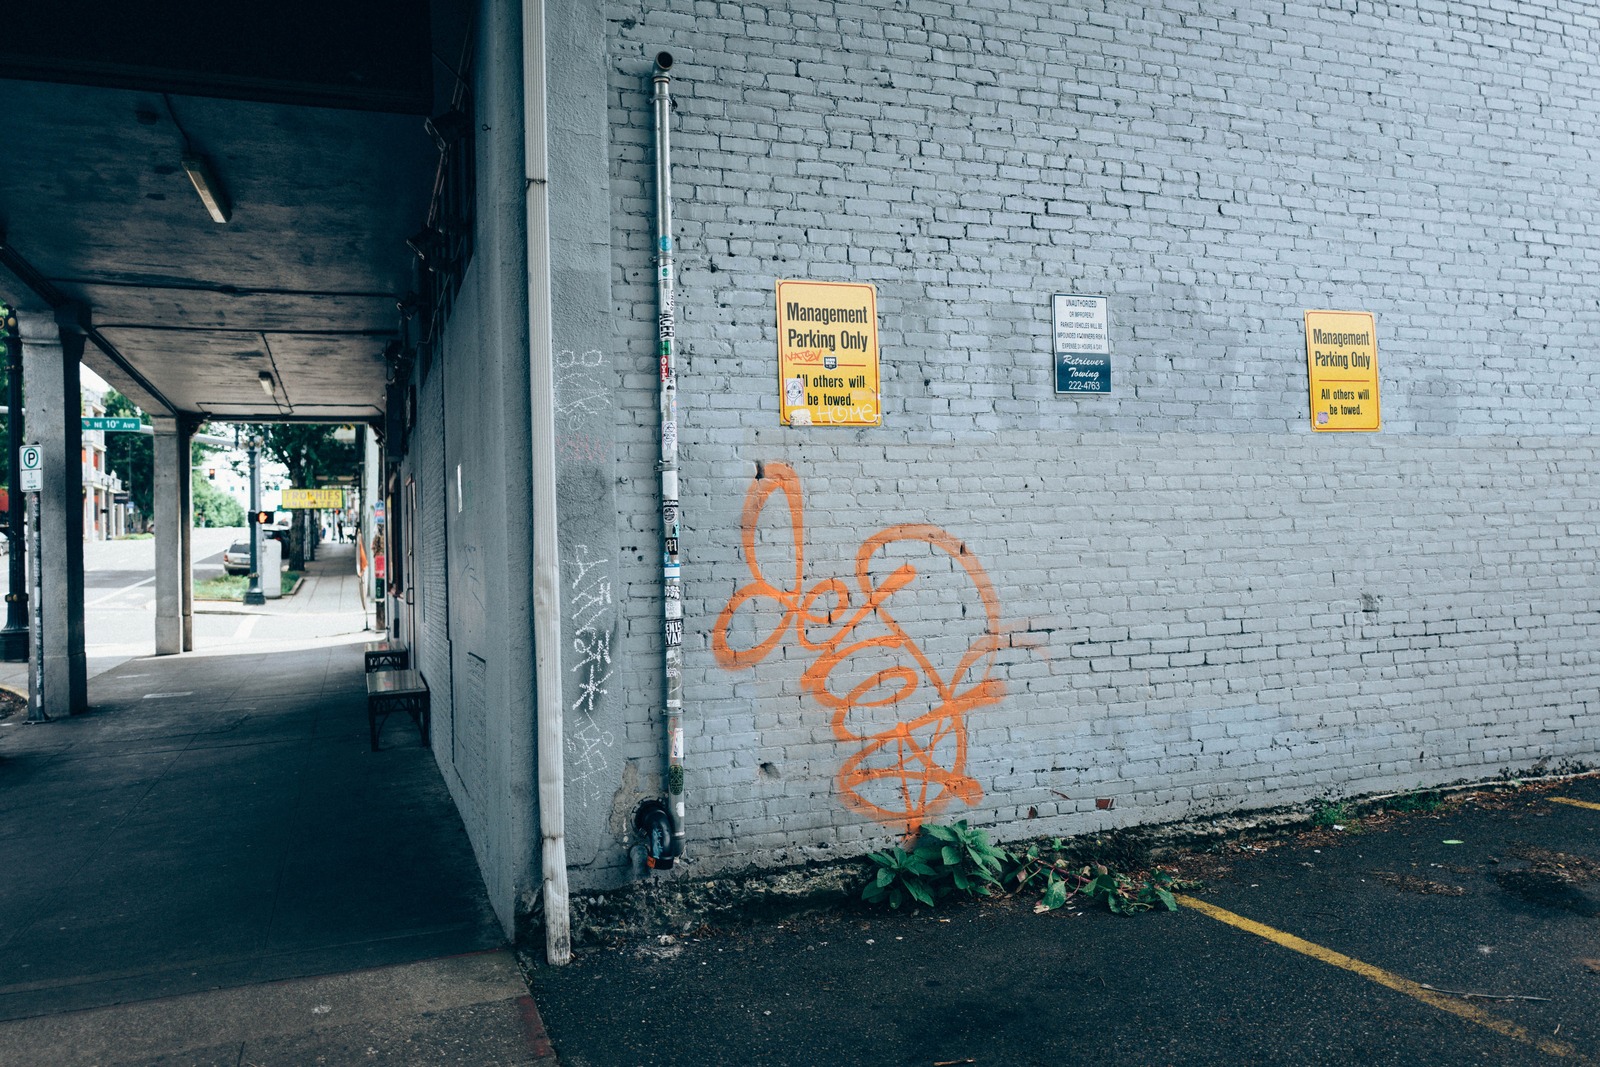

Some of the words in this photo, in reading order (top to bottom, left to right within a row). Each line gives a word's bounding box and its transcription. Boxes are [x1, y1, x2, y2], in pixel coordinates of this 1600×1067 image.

[787, 302, 868, 325] Management
[788, 328, 836, 352] Parking
[841, 331, 868, 352] Only
[1313, 329, 1370, 348] Management
[1063, 355, 1105, 366] Retriever
[1315, 351, 1348, 370] Parking
[1352, 352, 1370, 370] Only
[1068, 367, 1099, 380] Towing
[813, 376, 844, 389] others
[849, 375, 865, 388] will
[1069, 381, 1100, 390] 222-4763
[808, 393, 818, 406] be
[824, 393, 855, 406] towed.
[1321, 389, 1330, 400] All
[1334, 389, 1355, 400] others
[1358, 389, 1370, 400] will
[1330, 404, 1338, 415] be
[1341, 405, 1363, 416] towed.
[28, 452, 35, 465] P
